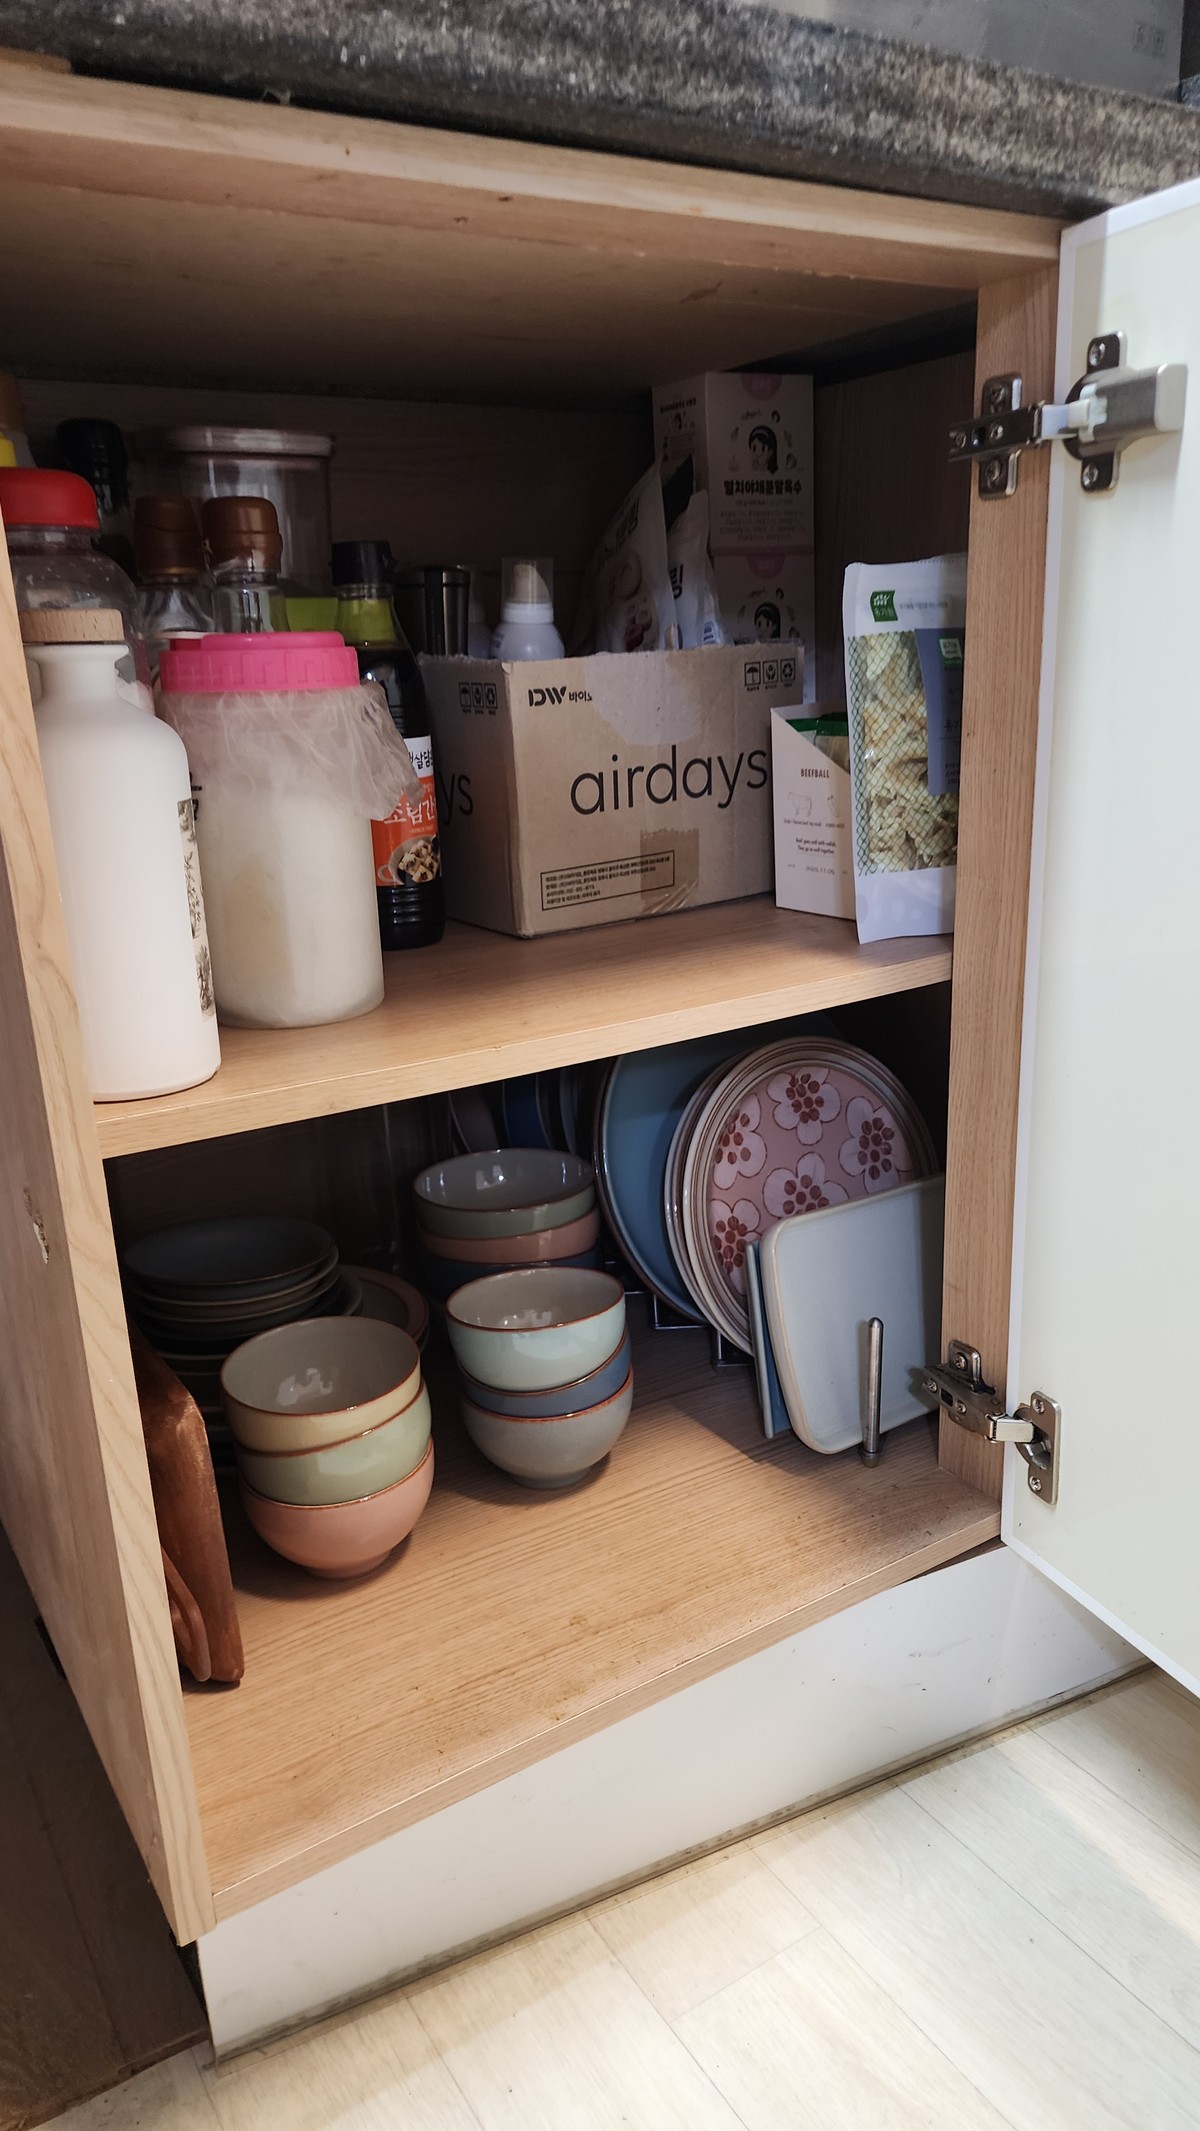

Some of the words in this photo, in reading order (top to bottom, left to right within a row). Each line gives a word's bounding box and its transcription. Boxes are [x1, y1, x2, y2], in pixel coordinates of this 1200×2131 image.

[528, 686, 567, 707] DW
[570, 744, 768, 816] airdays
[800, 768, 830, 779] BEEFBALL
